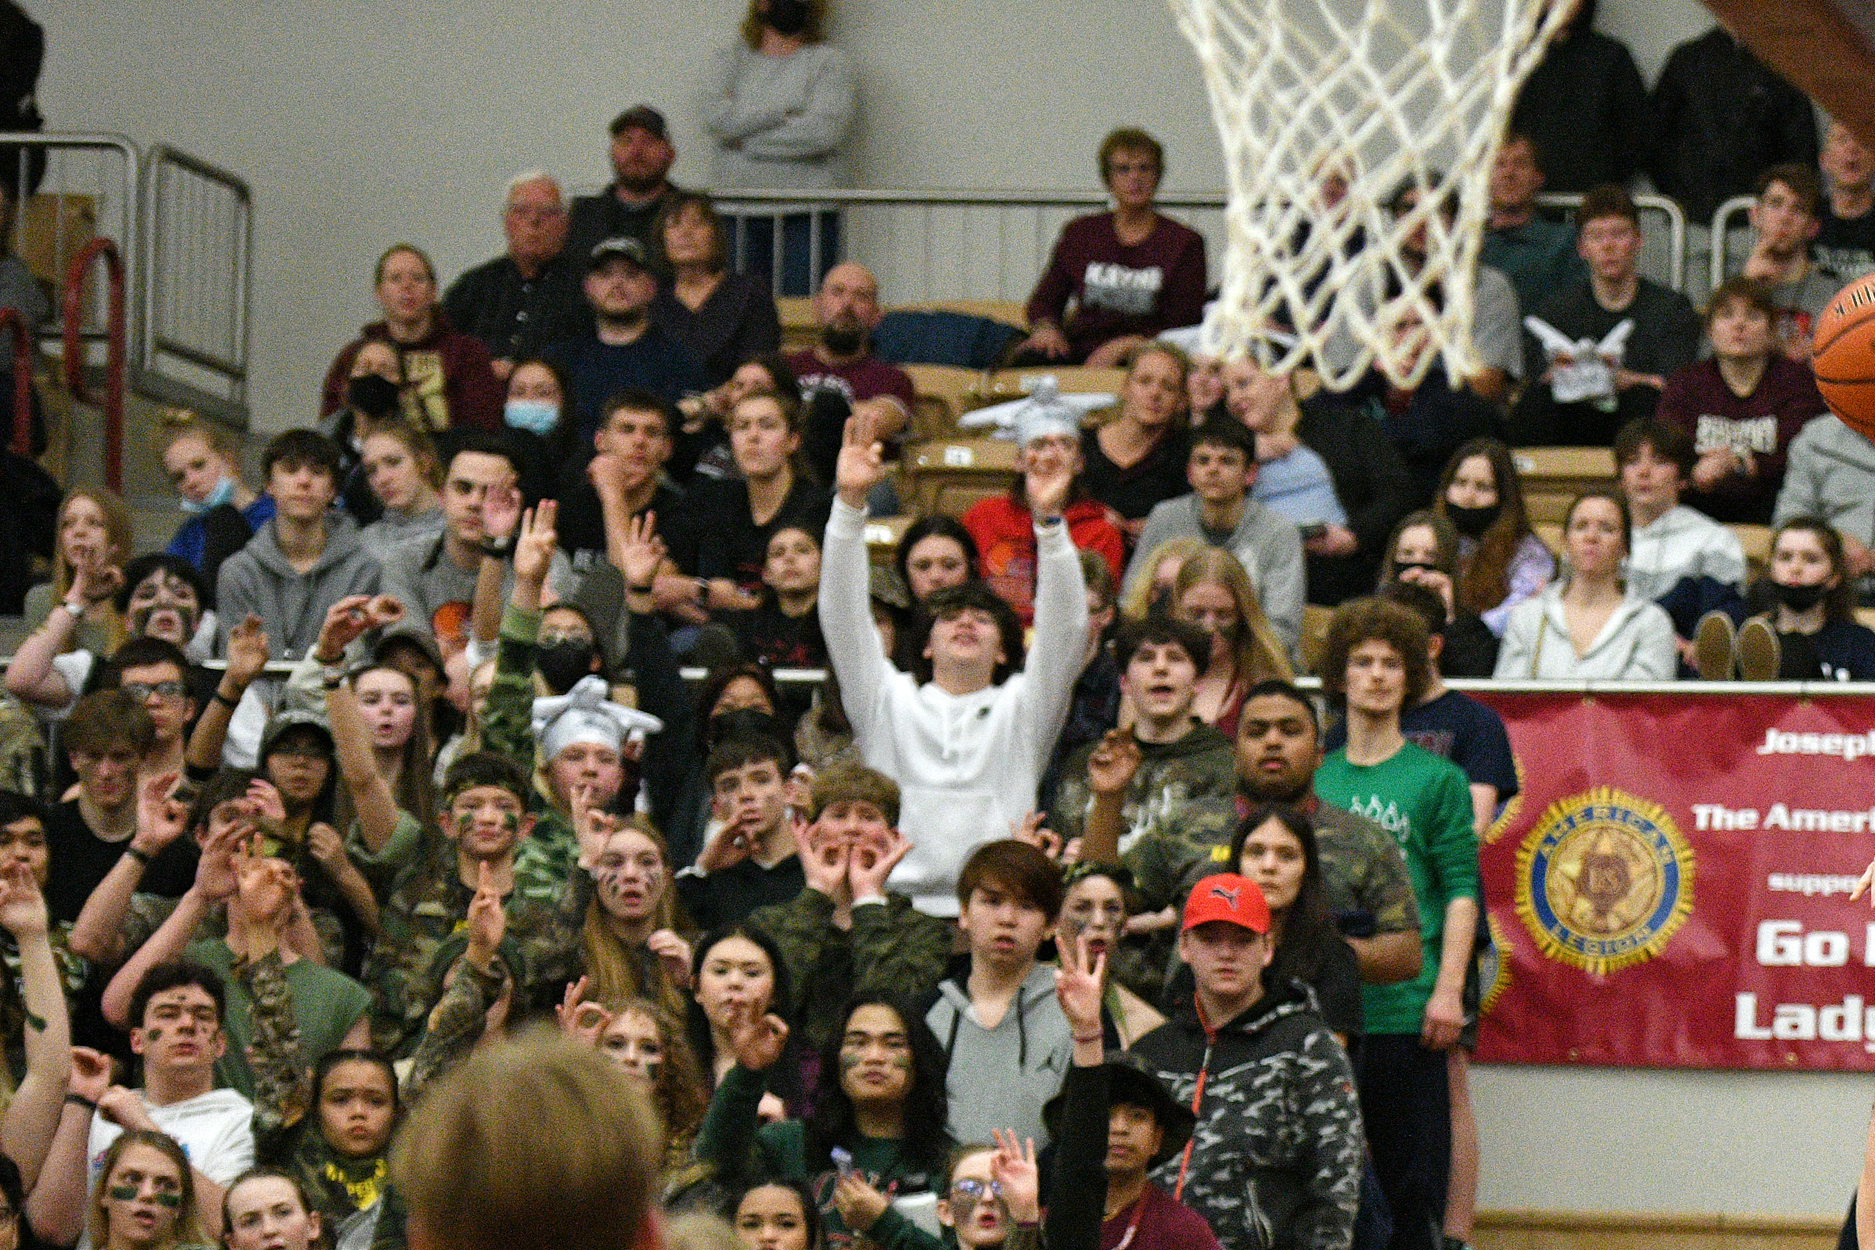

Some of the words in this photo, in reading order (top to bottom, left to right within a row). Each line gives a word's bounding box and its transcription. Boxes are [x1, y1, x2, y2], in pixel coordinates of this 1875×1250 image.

[1692, 803, 1761, 832] The
[1767, 872, 1866, 898] suppo
[1755, 919, 1850, 968] Go
